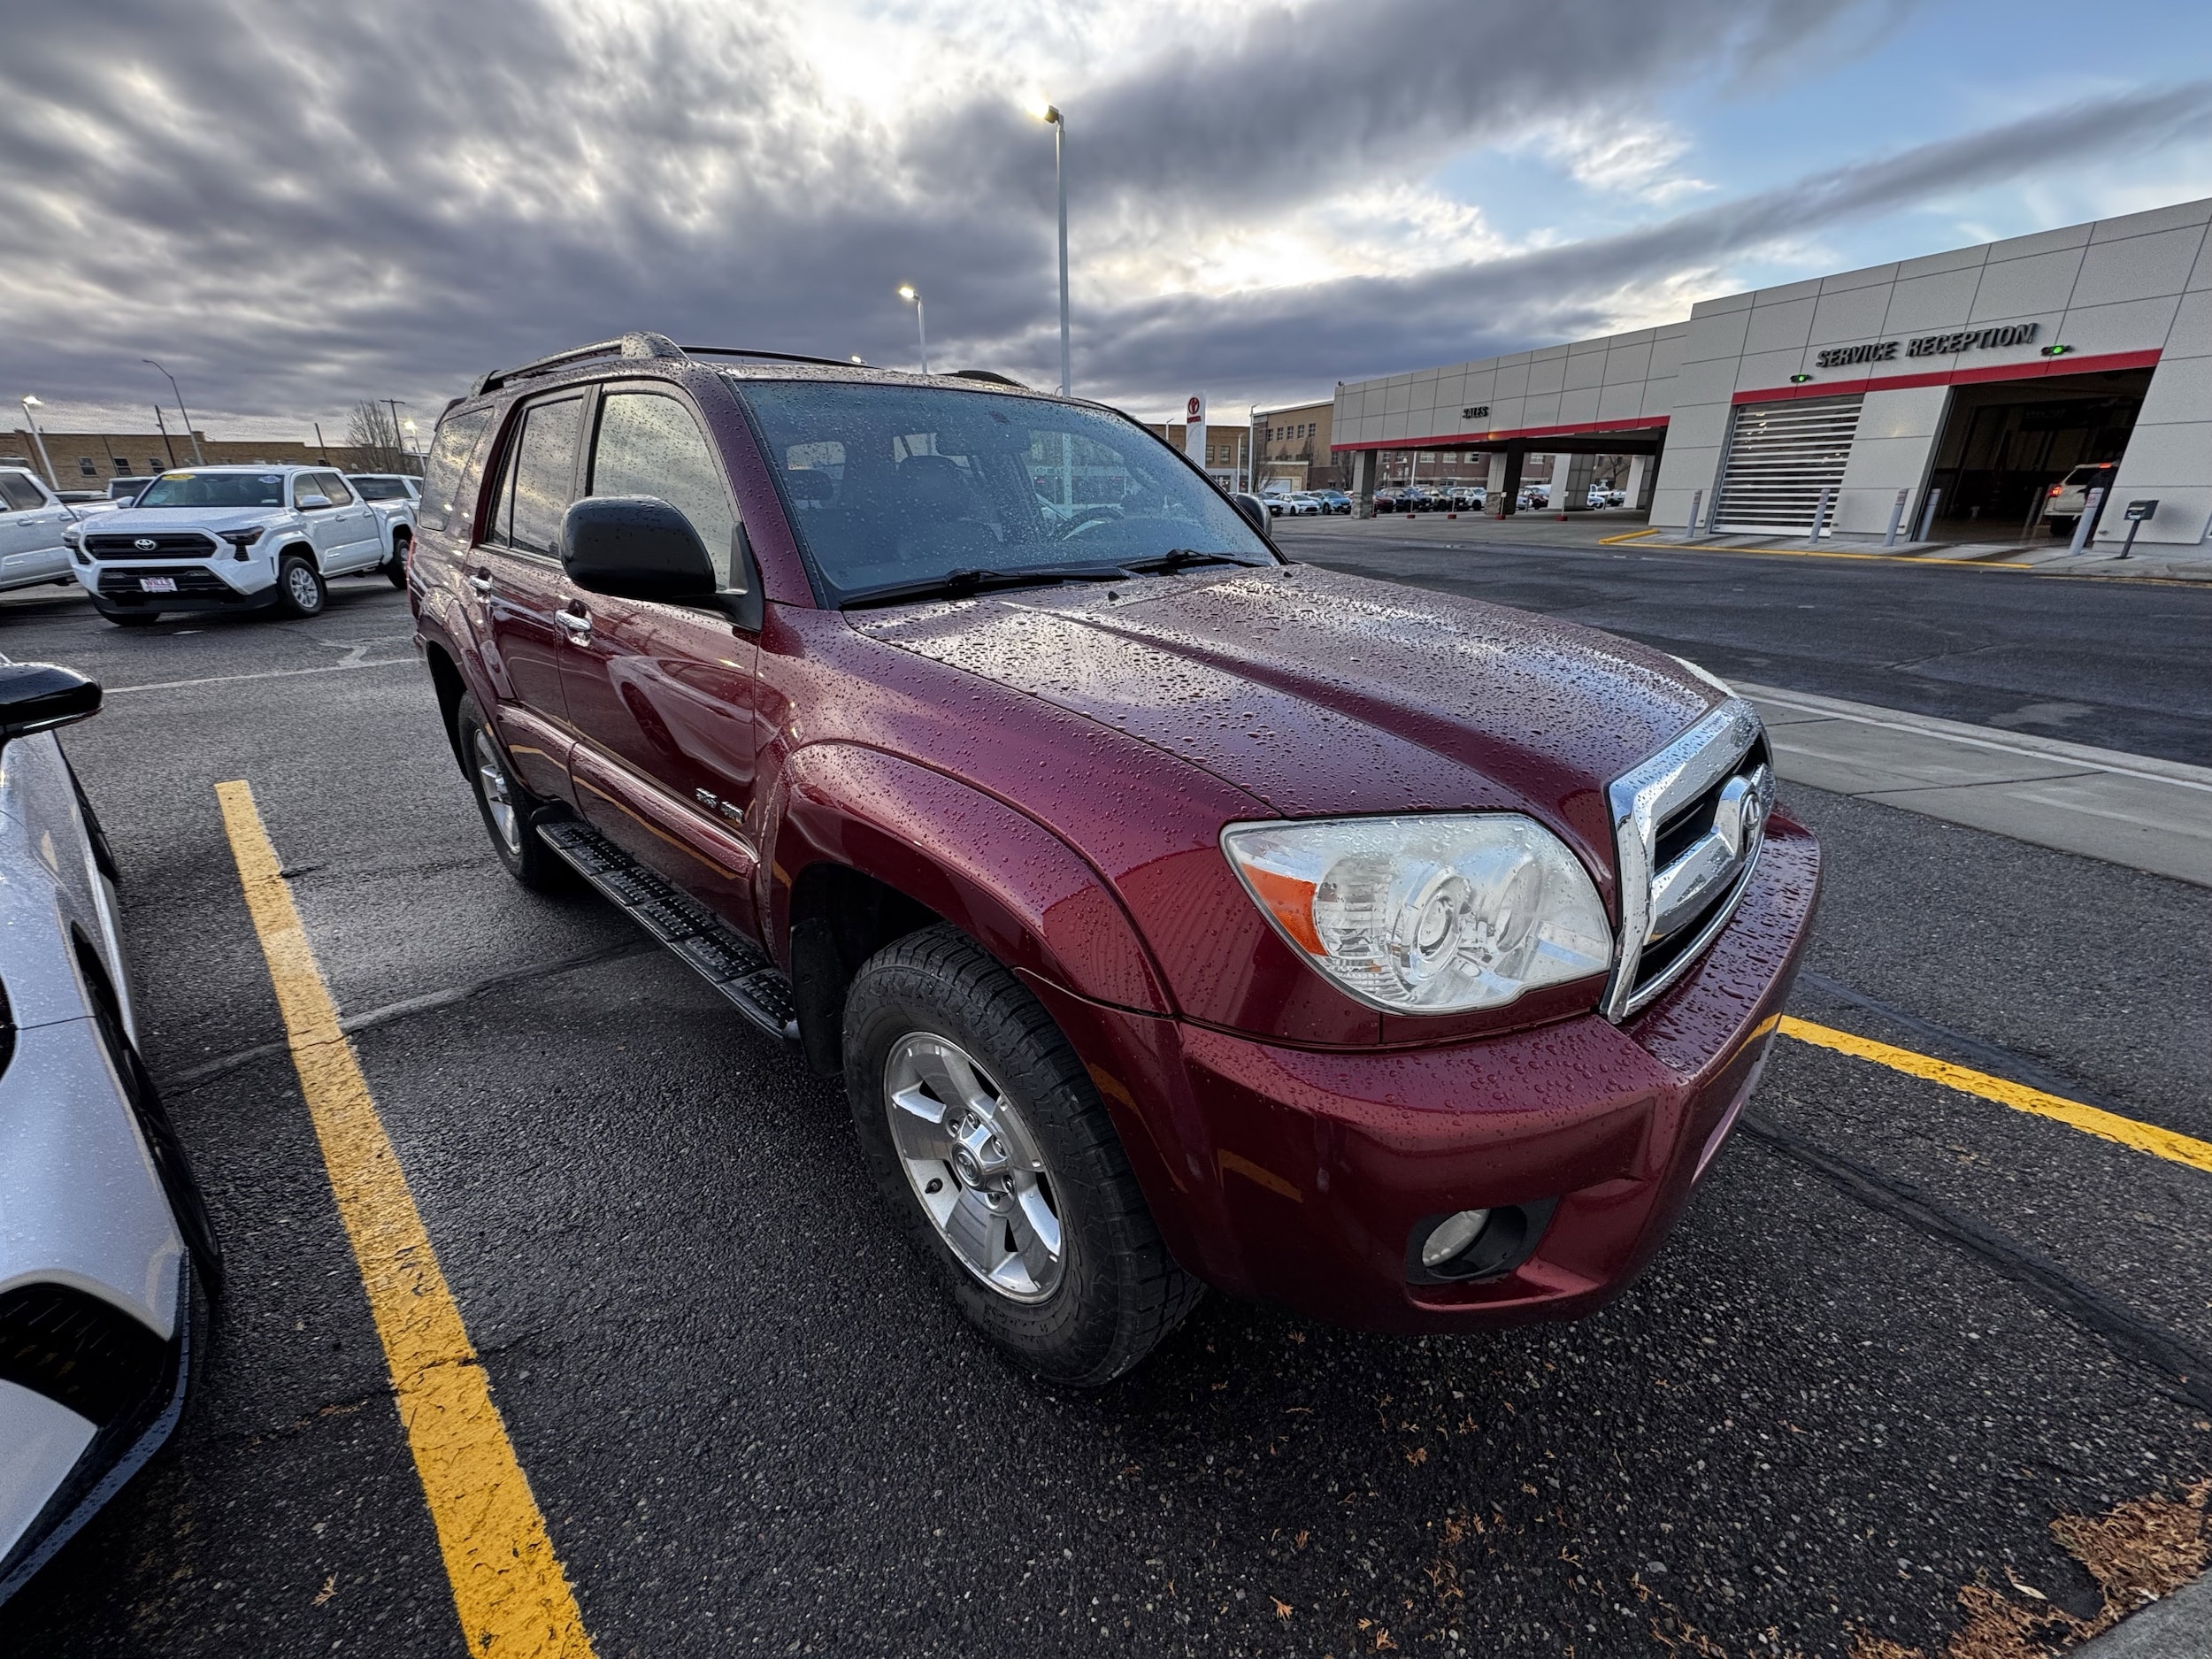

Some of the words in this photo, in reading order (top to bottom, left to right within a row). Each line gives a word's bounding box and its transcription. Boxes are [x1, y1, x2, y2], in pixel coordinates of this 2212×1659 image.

[1816, 342, 1898, 367] SERVICE
[1905, 323, 2038, 357] RECEPTION
[1463, 406, 1489, 419] SALES
